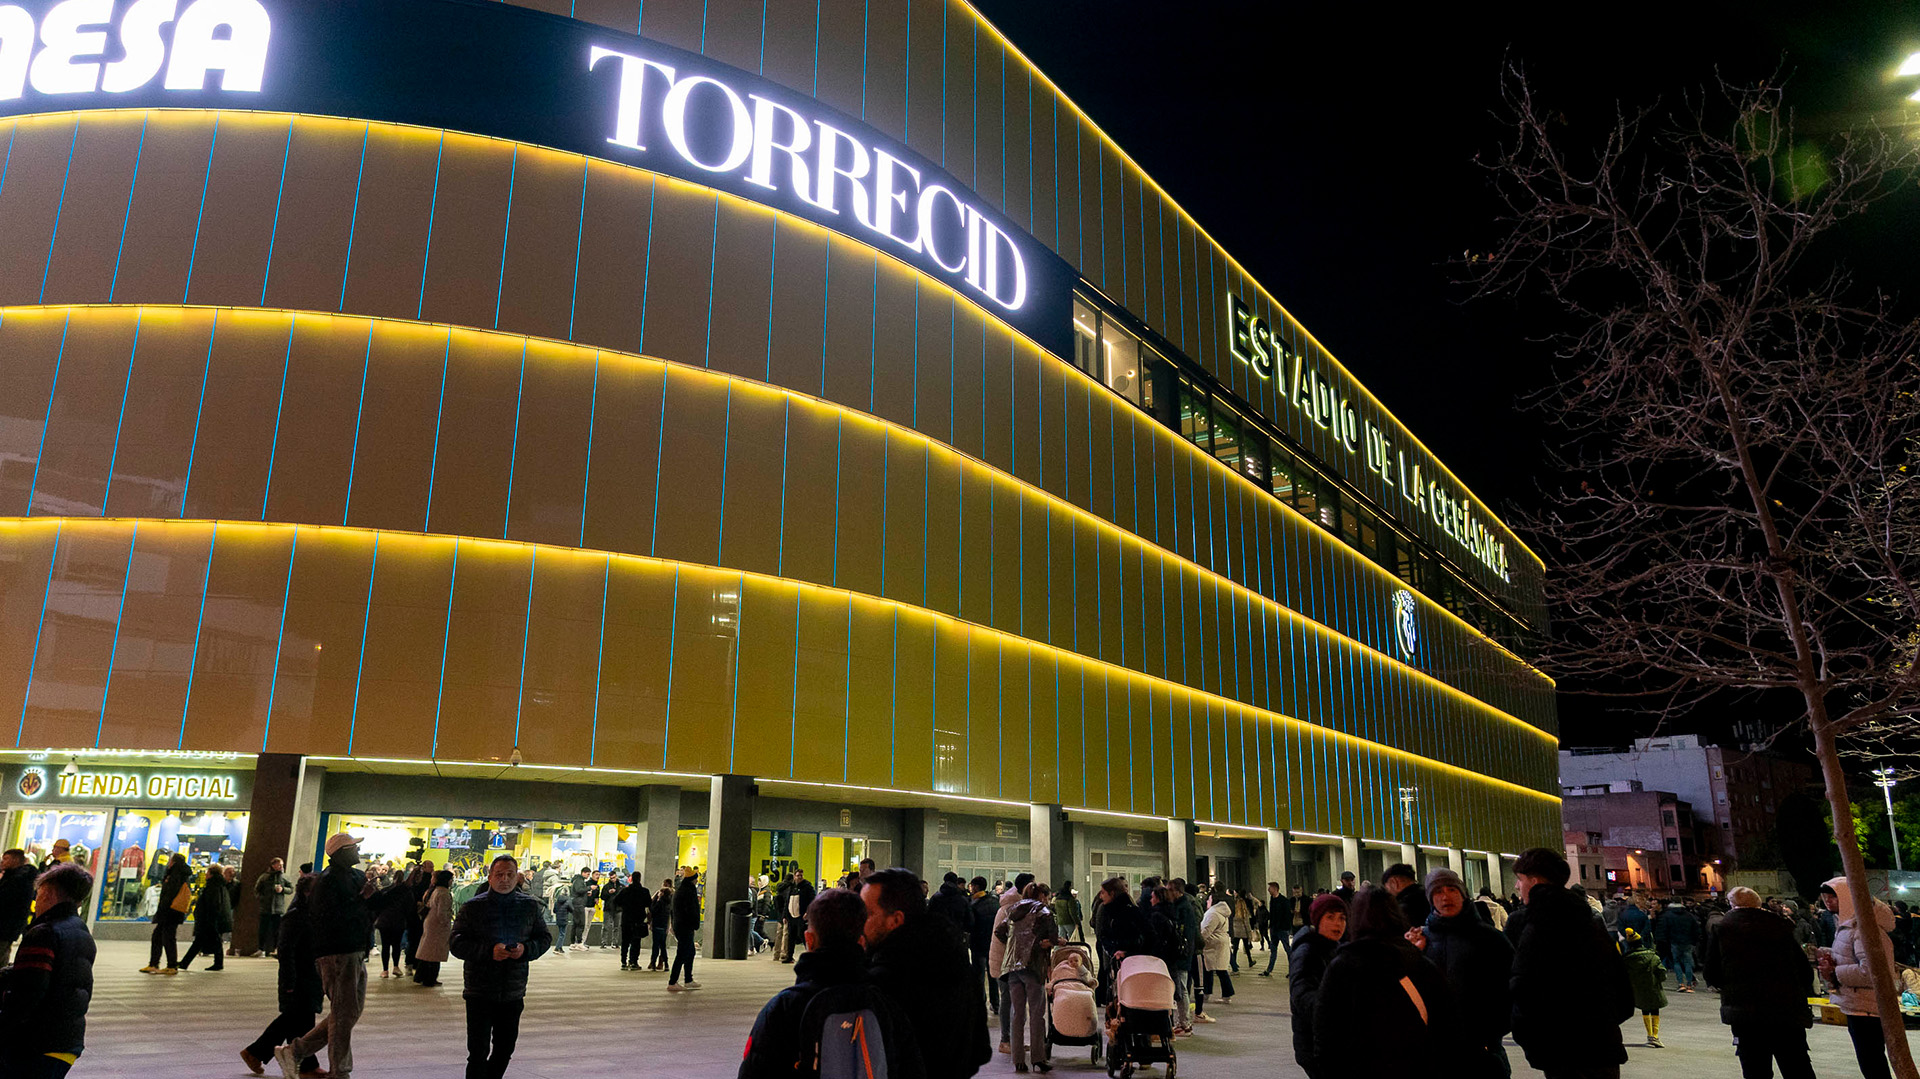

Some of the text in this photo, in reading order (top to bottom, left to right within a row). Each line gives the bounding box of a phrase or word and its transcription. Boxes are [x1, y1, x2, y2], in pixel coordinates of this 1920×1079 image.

[589, 46, 1027, 311] TORRECID
[1227, 291, 1359, 453] ESTADIO
[1365, 419, 1394, 487] DE
[1399, 449, 1427, 513] LA
[58, 774, 138, 796] TIENDA
[147, 776, 236, 799] OFICIAL
